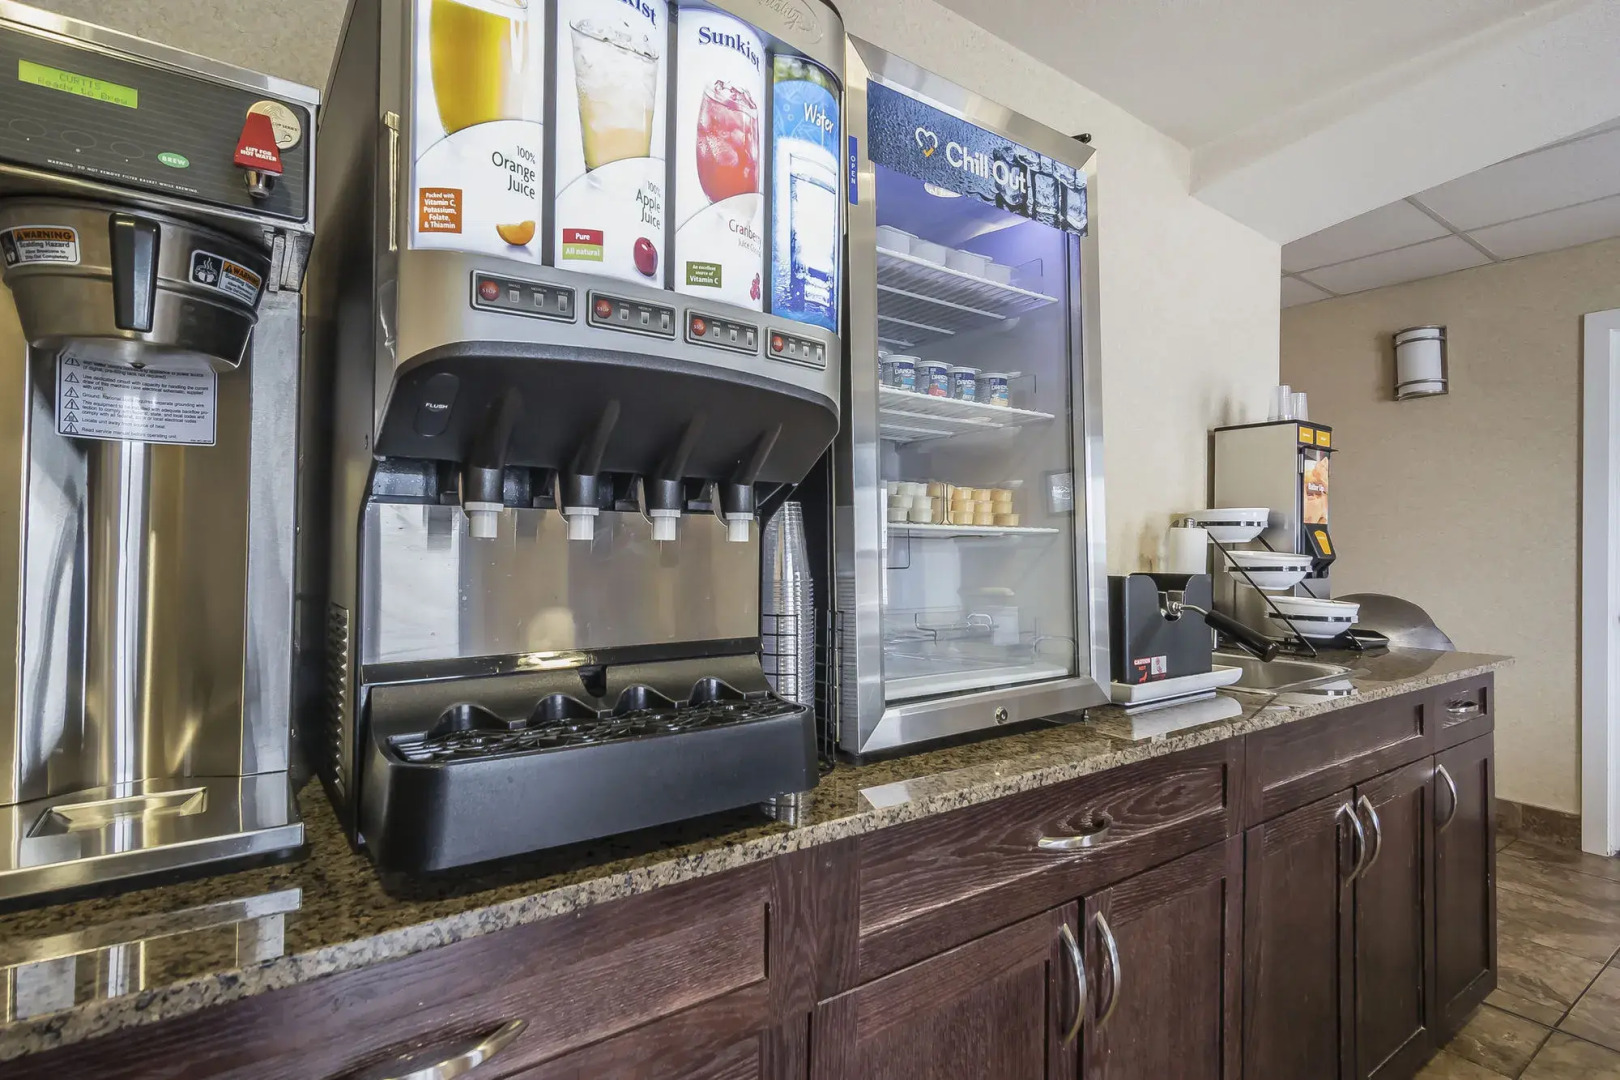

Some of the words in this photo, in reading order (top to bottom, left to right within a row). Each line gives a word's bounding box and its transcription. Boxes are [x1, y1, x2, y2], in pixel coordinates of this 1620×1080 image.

[698, 26, 759, 72] Sunkist
[59, 73, 101, 90] CURTIS
[38, 77, 73, 91] Ready
[101, 93, 127, 105] Brew
[804, 102, 834, 135] Water
[161, 155, 186, 166] BREW
[255, 153, 276, 162] WATER
[516, 145, 536, 164] 100%
[492, 151, 536, 183] Orange
[945, 141, 989, 180] Chill
[991, 160, 1026, 194] Out
[507, 175, 536, 200] Juice
[648, 180, 661, 198] 100%
[424, 206, 457, 214] Potassium,
[636, 188, 661, 214] Apple
[430, 221, 456, 229] Thiamin
[640, 206, 661, 230] Juice
[24, 230, 71, 240] WARNING
[575, 232, 590, 241] Pure
[576, 248, 600, 256] natural
[234, 266, 259, 284] WARNING
[690, 276, 713, 284] Vitamin
[1134, 657, 1150, 666] CAUTION
